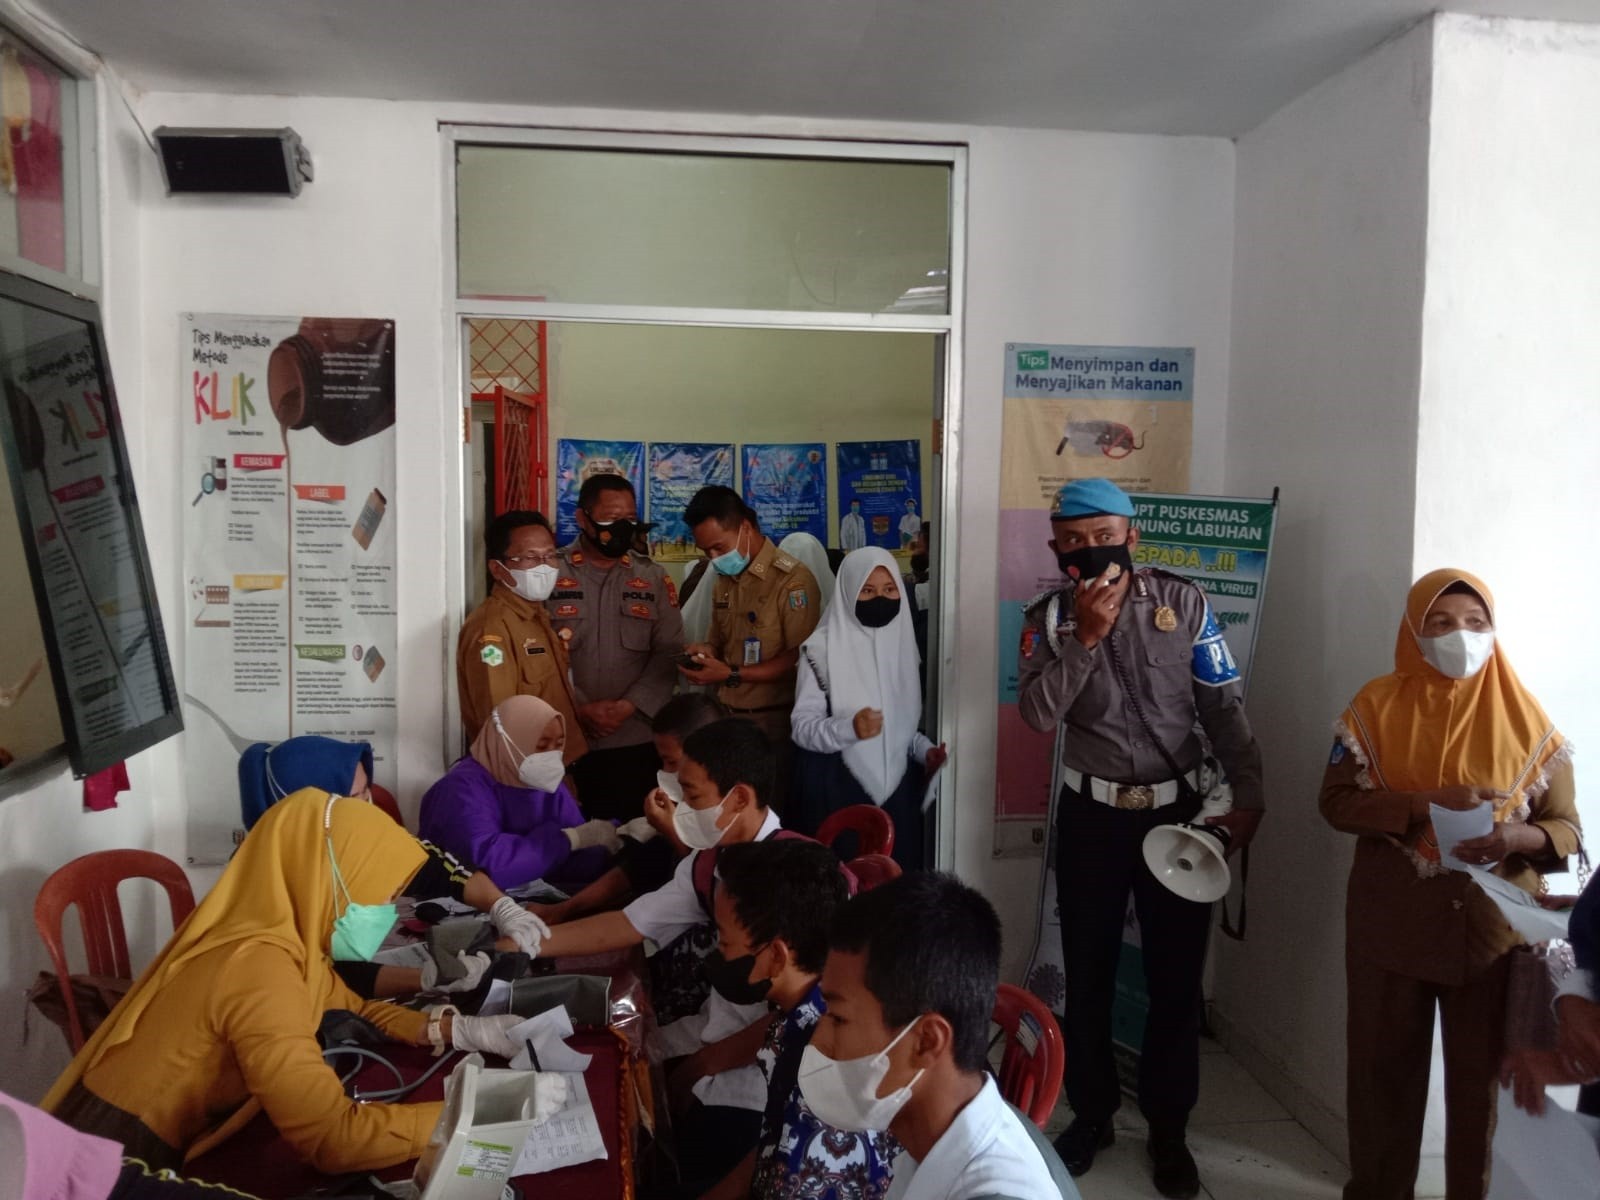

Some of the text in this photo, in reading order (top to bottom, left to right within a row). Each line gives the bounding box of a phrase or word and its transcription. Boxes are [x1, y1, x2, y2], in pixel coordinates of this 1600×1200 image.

[193, 329, 271, 349] Tips Menggunakan
[192, 350, 228, 367] Metode
[1021, 353, 1179, 374] Tips Menyimpan dan
[1015, 374, 1183, 391] Menyajikan Makanan
[193, 370, 256, 425] KLIK
[1160, 504, 1249, 523] PUSKESMAS
[1186, 521, 1262, 541] LABUHAN
[1221, 582, 1255, 596] VIRUS
